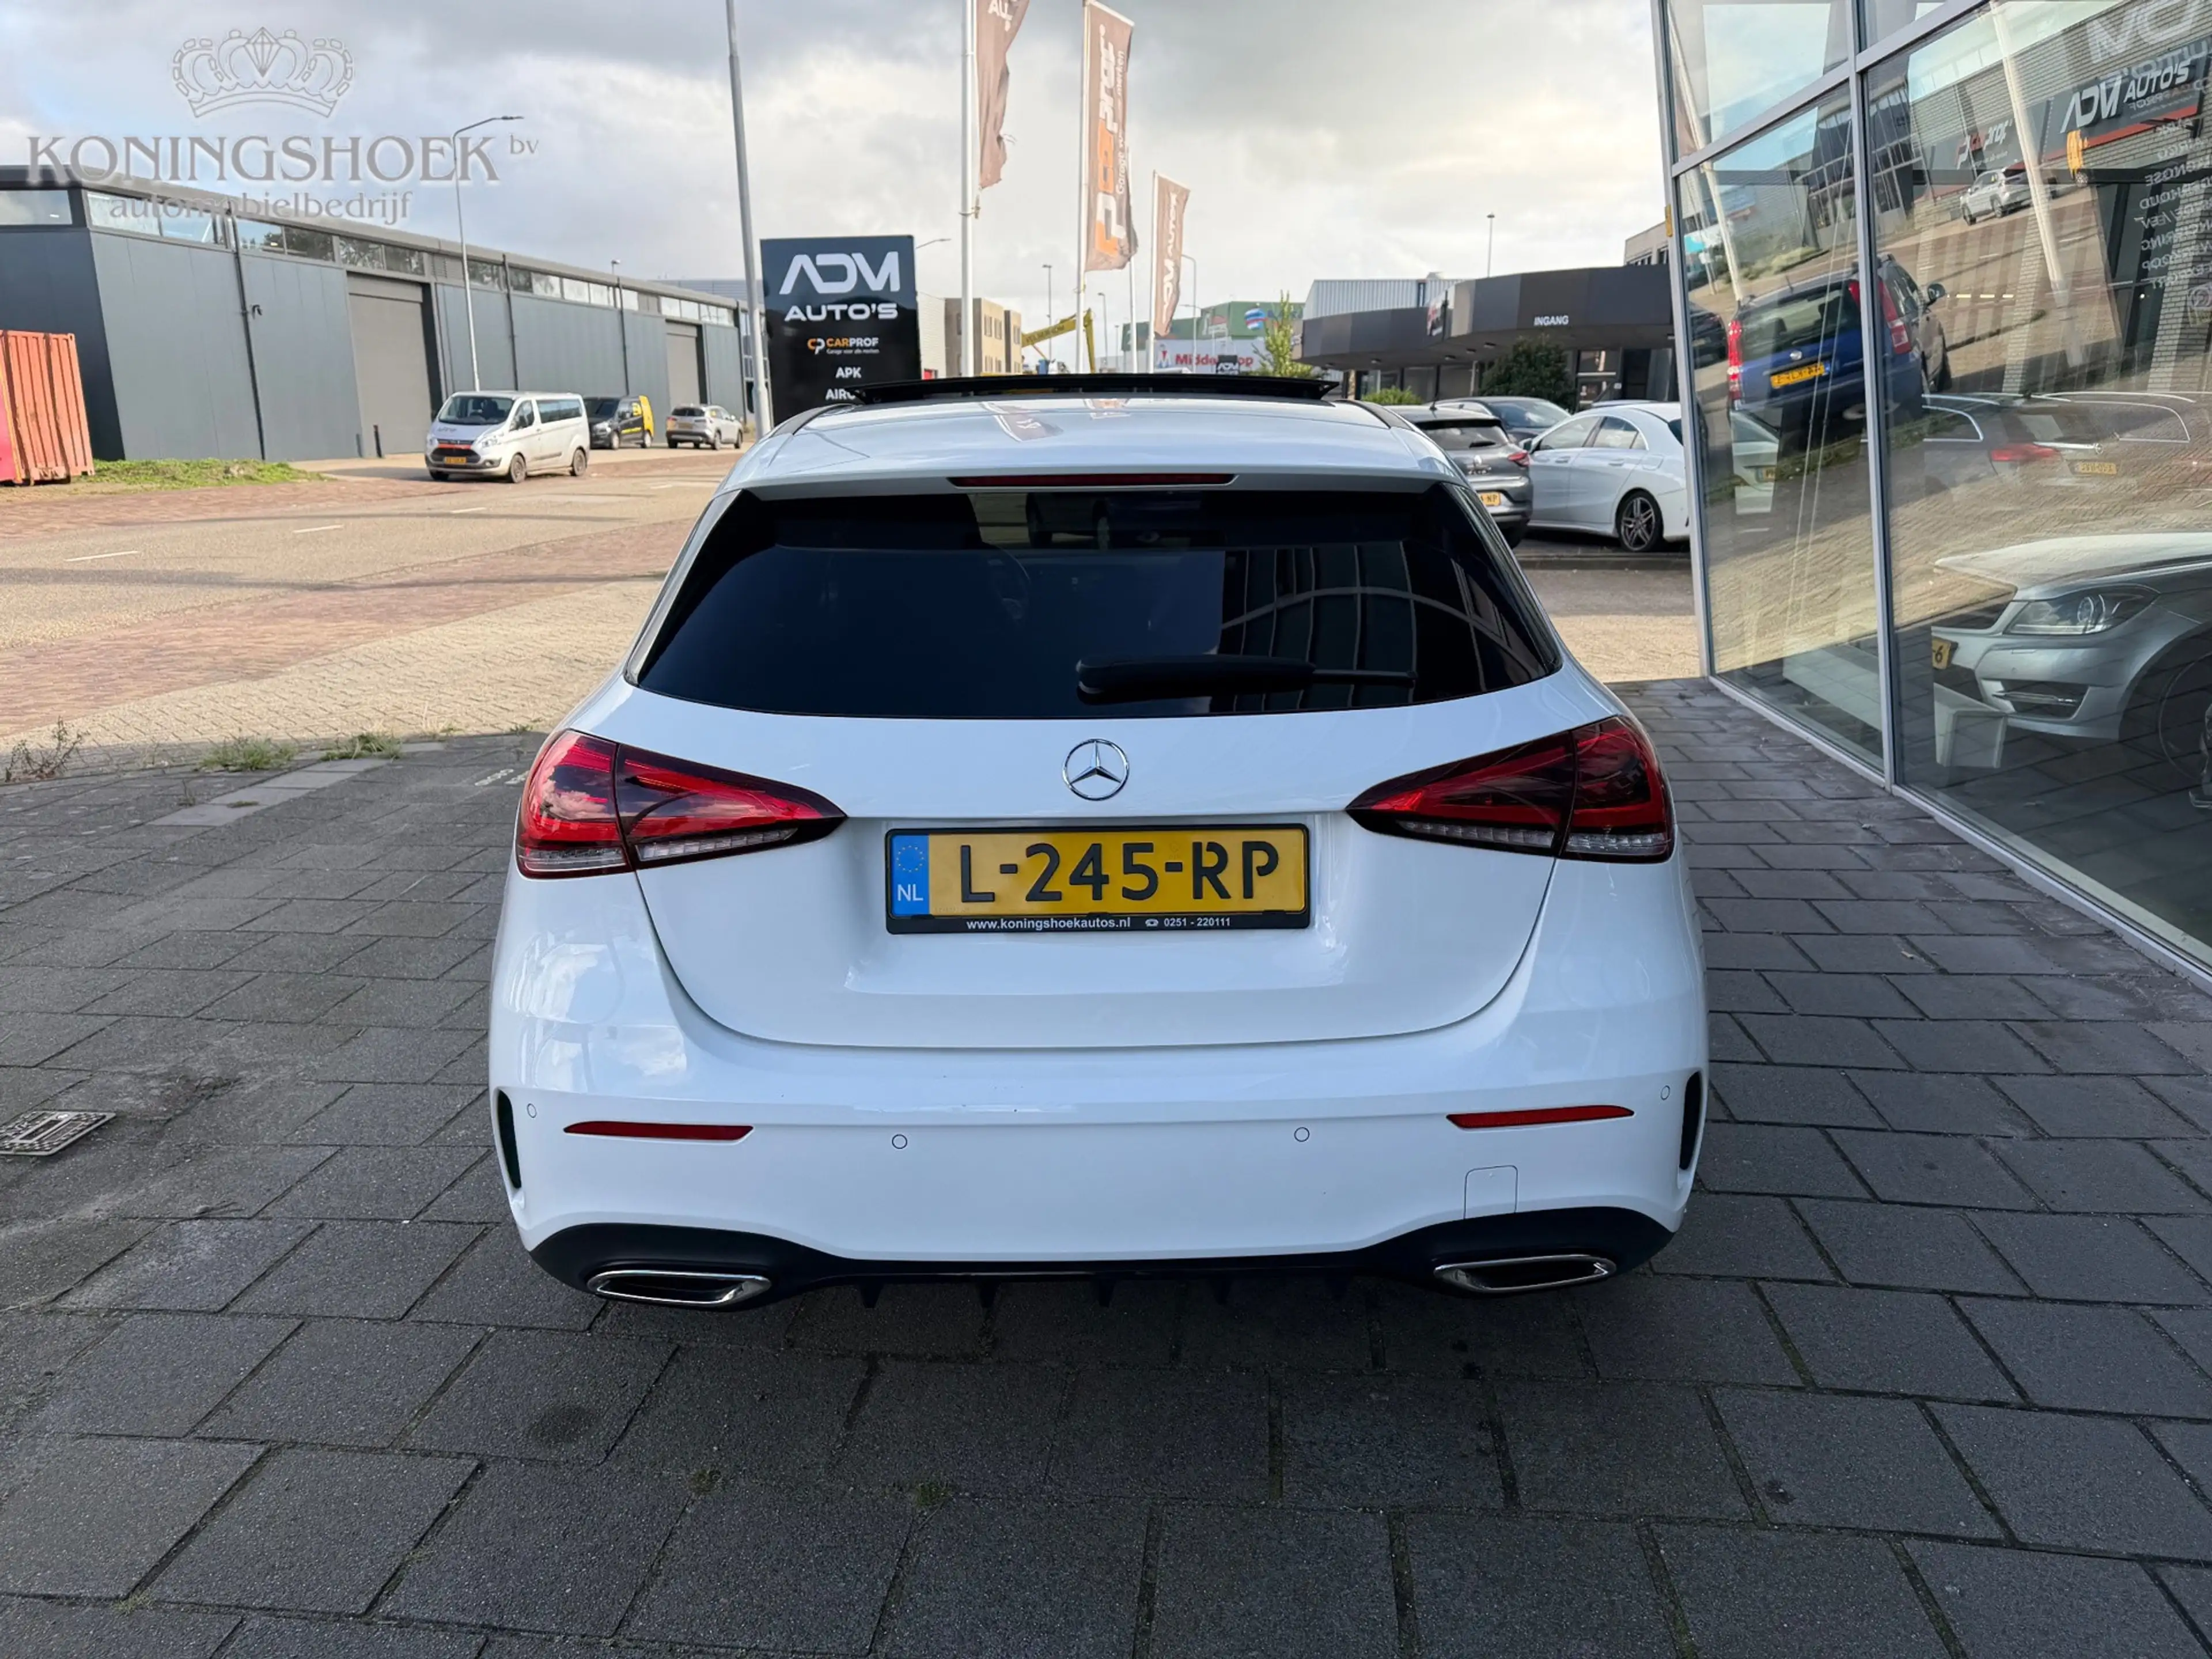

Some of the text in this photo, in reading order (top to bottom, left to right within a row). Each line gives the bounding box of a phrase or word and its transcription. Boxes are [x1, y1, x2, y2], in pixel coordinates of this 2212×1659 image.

[2124, 60, 2191, 103] AUTO'S
[779, 251, 900, 294] ADM
[784, 303, 898, 321] AUTO'S
[1533, 315, 1569, 326] INGANG
[826, 338, 879, 347] CARPROF
[835, 366, 862, 378] APK
[961, 841, 1279, 903] L-245-RP
[897, 884, 923, 902] NL
[967, 917, 1131, 931] www.koningshoekautos.nl
[1164, 918, 1187, 926] 0251
[1196, 917, 1230, 926] 220111
